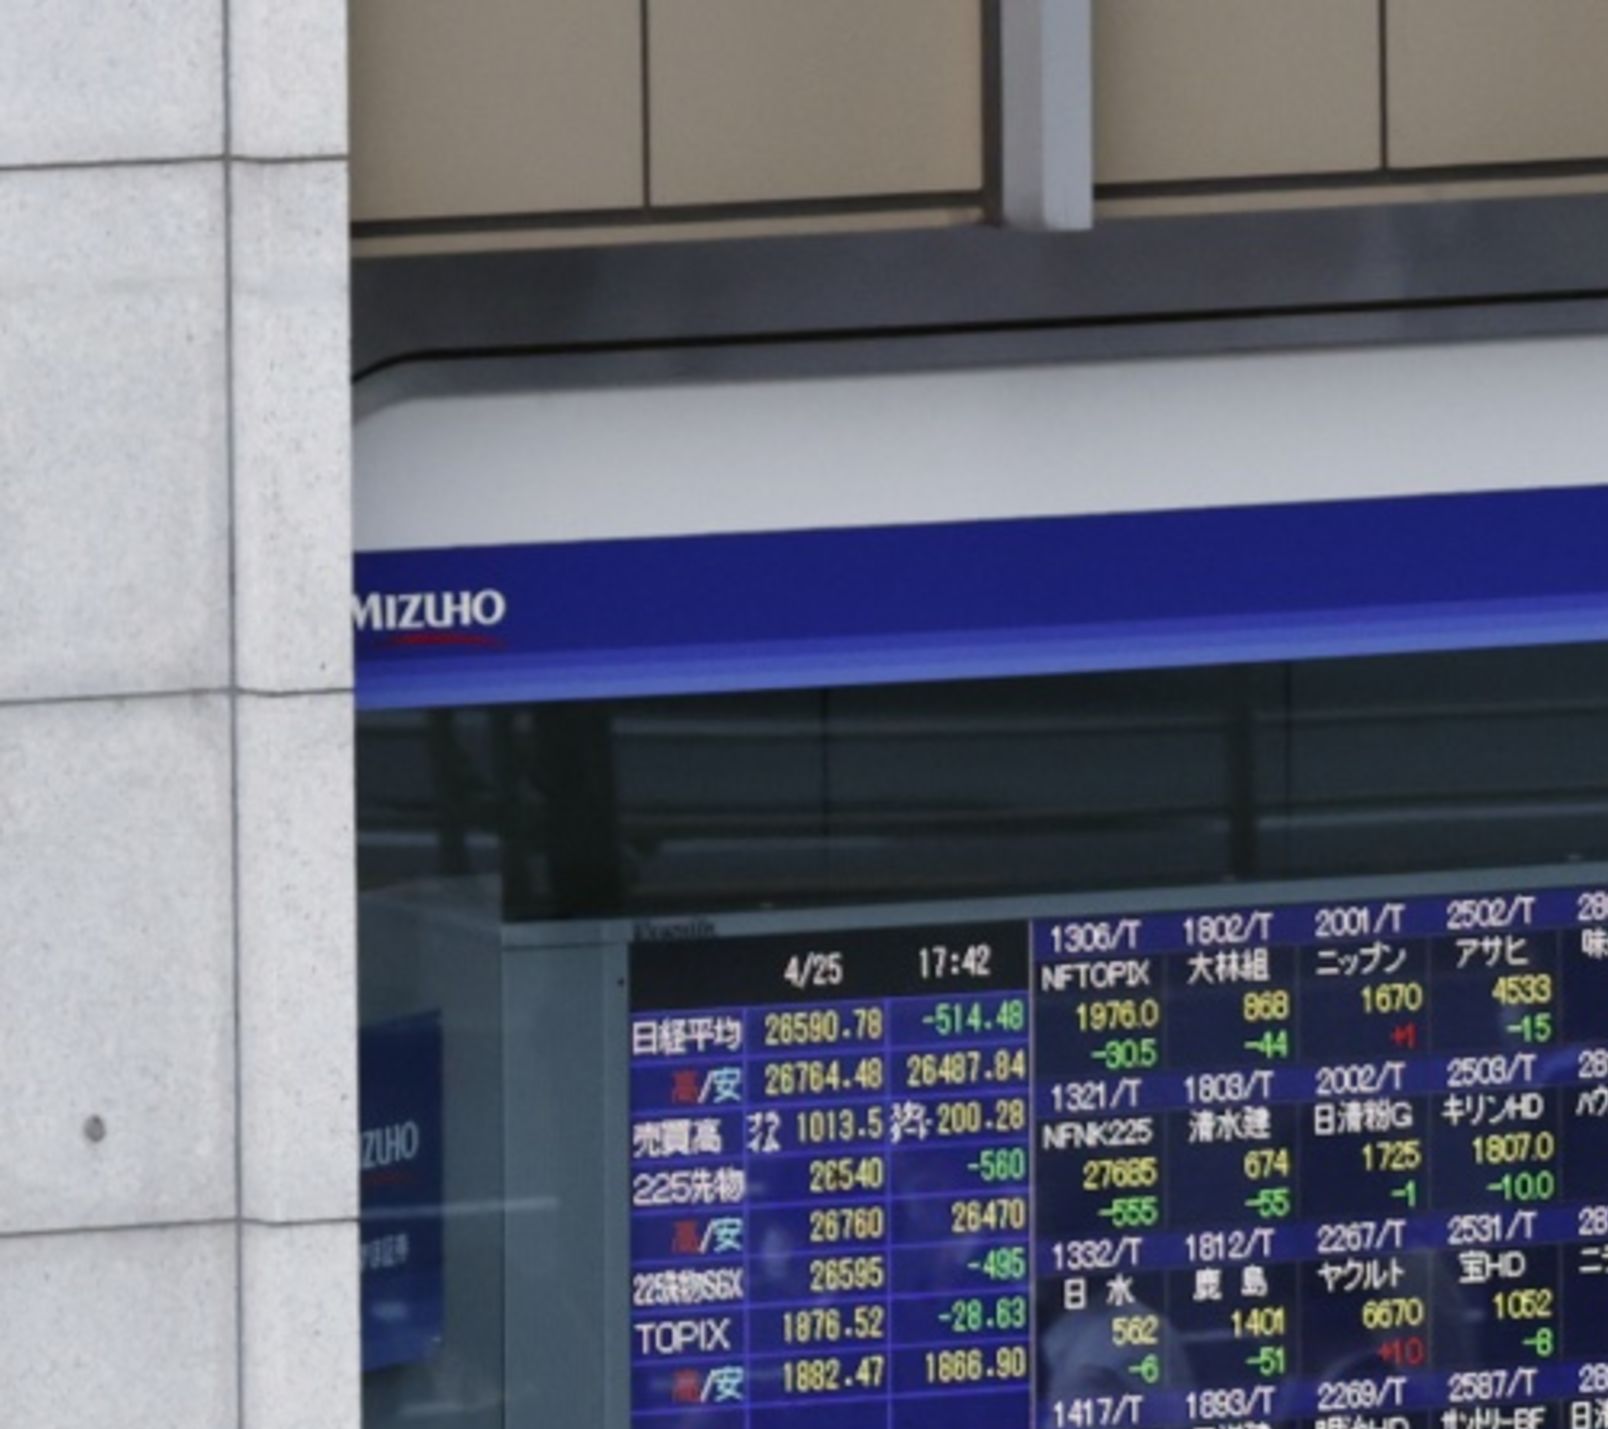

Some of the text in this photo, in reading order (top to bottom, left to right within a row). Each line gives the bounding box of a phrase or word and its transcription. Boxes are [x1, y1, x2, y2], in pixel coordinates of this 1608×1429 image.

[352, 588, 507, 631] MIZUHO
[1183, 911, 1274, 946] 1802/T
[1315, 902, 1406, 938] 2001/T
[1446, 895, 1536, 930] 2502/T
[1051, 918, 1141, 953] 1306/T
[1455, 935, 1529, 968] アサヒ
[783, 944, 991, 988] 4/25 17:42
[1188, 947, 1270, 984] 大林組
[1316, 940, 1407, 976] ニップン
[632, 999, 1024, 1055] 日経平均 26590.78 -514.48
[764, 1057, 883, 1096] 26764.48
[906, 1049, 1026, 1087] 26487.84
[1184, 1069, 1275, 1104] 1803/T
[1315, 1060, 1406, 1097] 2002/T
[1446, 1052, 1537, 1088] 2503/T
[1051, 1077, 1142, 1113] 1321/T
[797, 1106, 884, 1143] 1013.5
[1043, 1117, 1153, 1149] NFNK225
[1189, 1105, 1271, 1143] 清水建
[361, 1119, 420, 1170] ZUHO
[633, 1167, 746, 1206] 225先物
[967, 1147, 1026, 1182] -560
[809, 1206, 885, 1242] 26760
[951, 1197, 1026, 1233] 26470
[1317, 1218, 1407, 1254] 2267/T
[1447, 1209, 1538, 1246] 2531/T
[1052, 1236, 1143, 1271] 1332/T
[1185, 1227, 1275, 1262] 1812/T
[809, 1255, 885, 1292] 26595
[967, 1246, 1026, 1280] -495
[1317, 1257, 1405, 1292] ヤクルト
[634, 1295, 1026, 1354] TOPIX 1876.52 -28.63
[783, 1355, 885, 1393] 1882.47
[925, 1345, 1027, 1383] 1866.90
[1447, 1366, 1538, 1403] 2587/T
[1053, 1394, 1143, 1429] 1417/T
[1185, 1385, 1276, 1419] 1893/T
[1317, 1375, 1407, 1412] 2269/T
